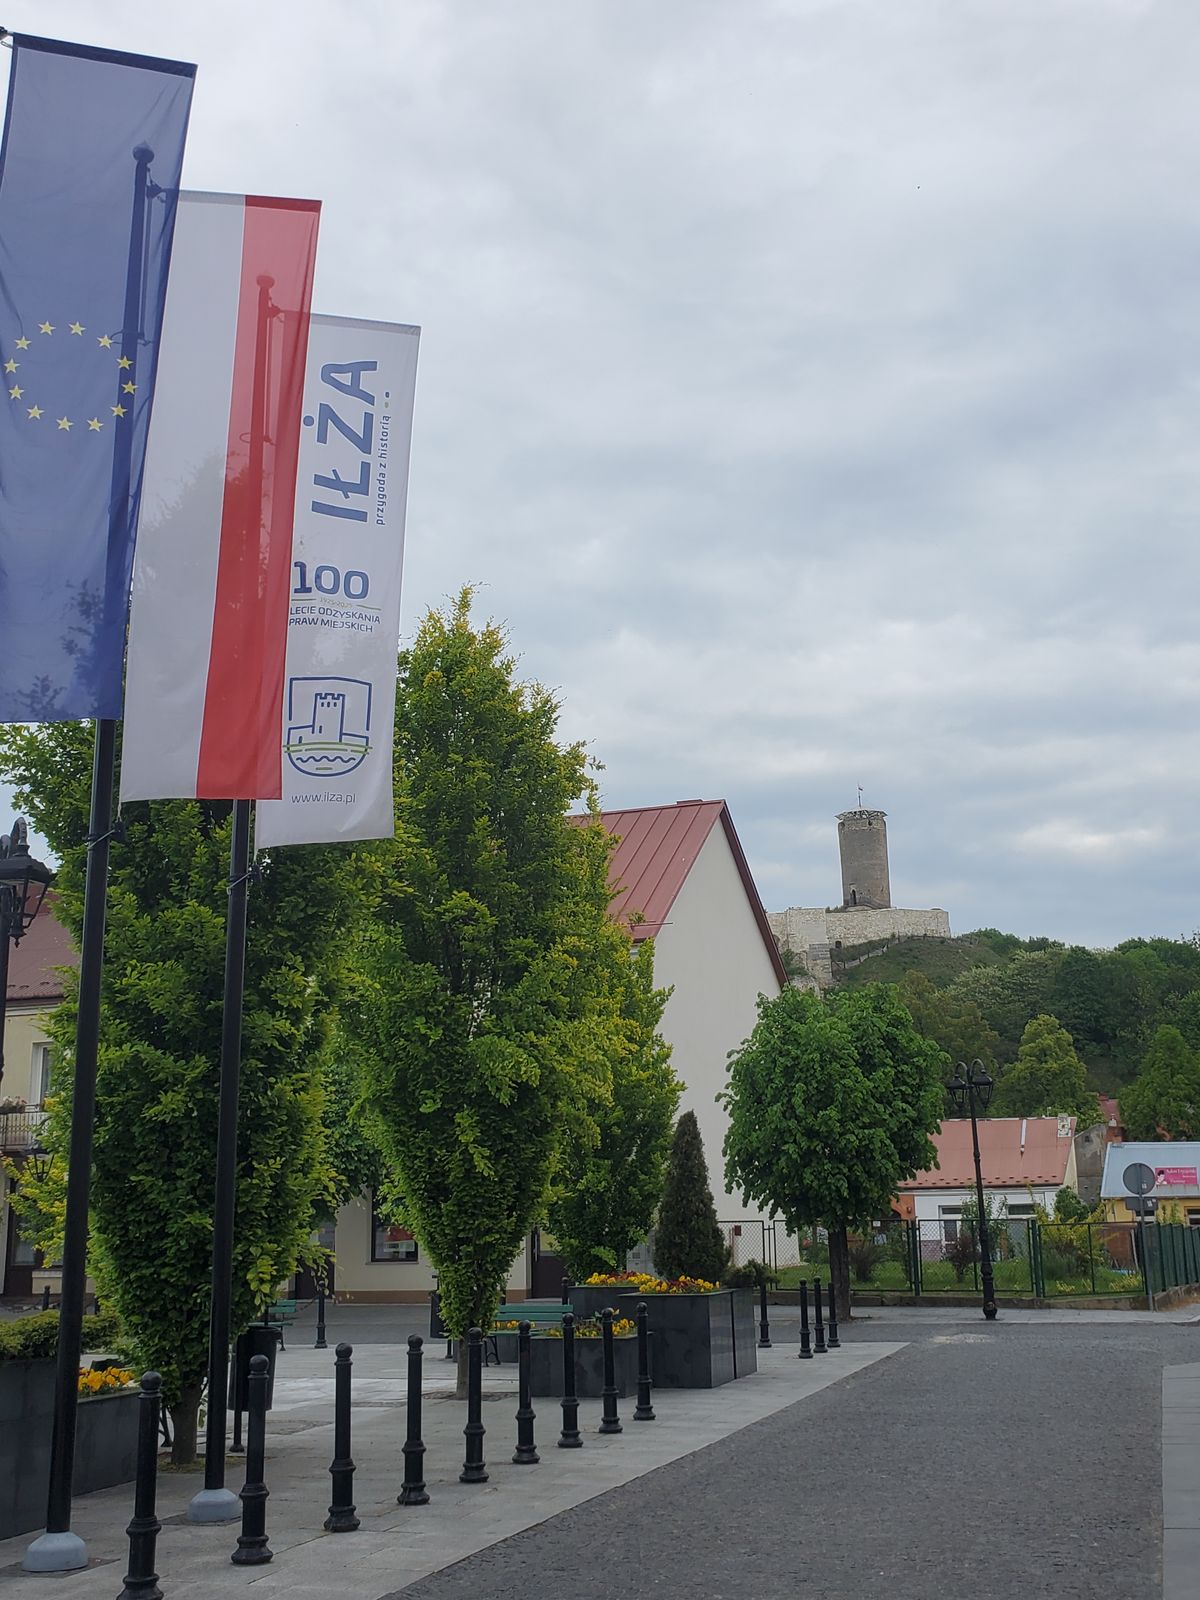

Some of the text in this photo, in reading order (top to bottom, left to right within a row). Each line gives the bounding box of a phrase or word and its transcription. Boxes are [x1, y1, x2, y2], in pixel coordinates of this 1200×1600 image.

[303, 361, 377, 522] IŁŻA
[378, 415, 391, 459] historią
[376, 475, 387, 526] przygoda
[293, 561, 370, 600] 100
[288, 617, 373, 632] PRAW MIEJSKICH
[290, 605, 381, 624] LECIE ODZYSKANIA
[291, 791, 356, 805] www.ilza.pl
